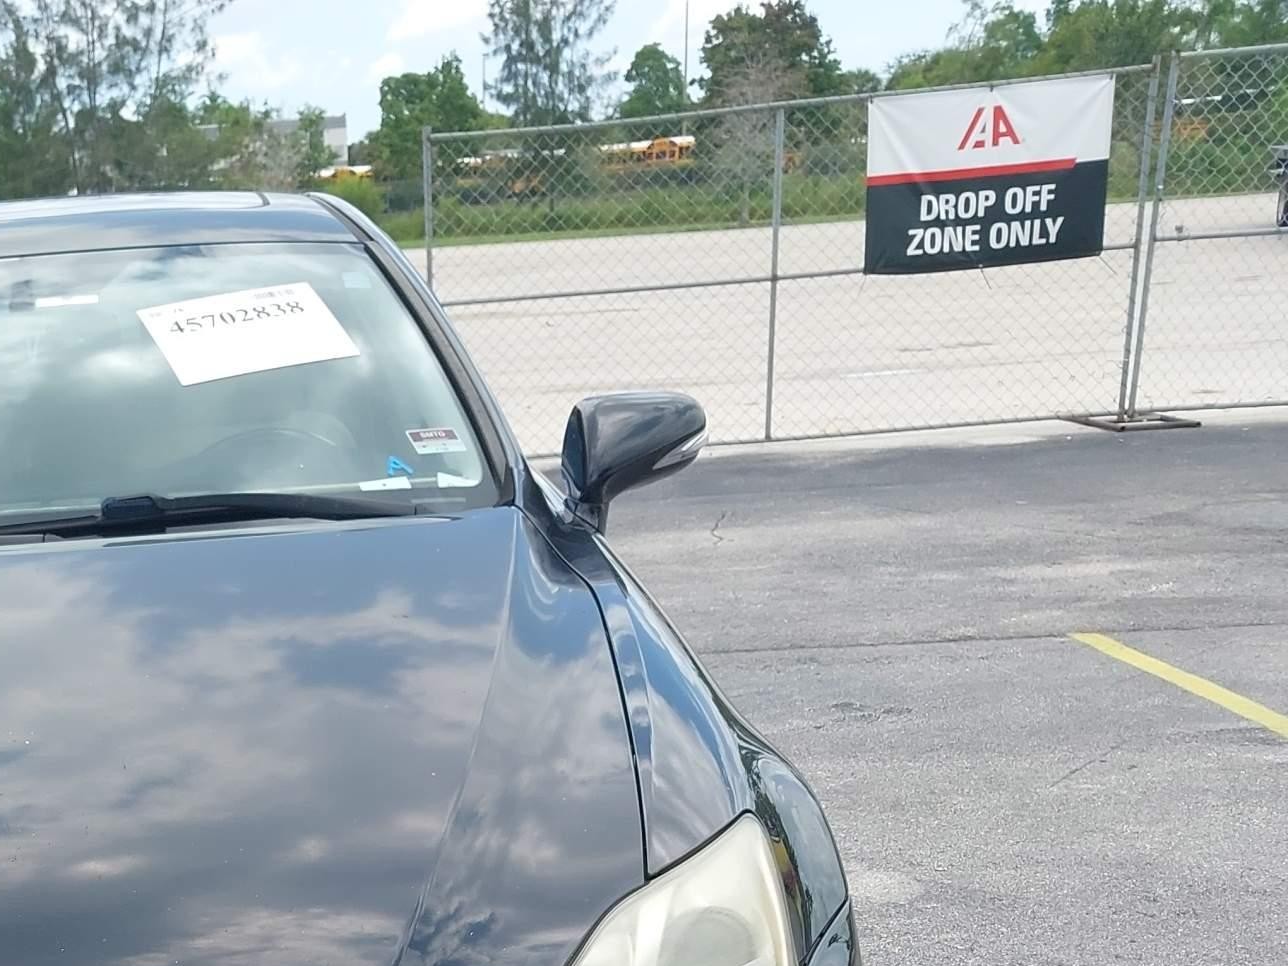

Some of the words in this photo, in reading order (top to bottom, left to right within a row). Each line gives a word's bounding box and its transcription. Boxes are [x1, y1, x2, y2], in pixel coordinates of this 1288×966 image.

[919, 189, 997, 222] DROP
[1004, 183, 1057, 214] OFF
[906, 225, 981, 257] ZONE
[988, 216, 1065, 248] ONLY
[170, 300, 305, 334] 45702838
